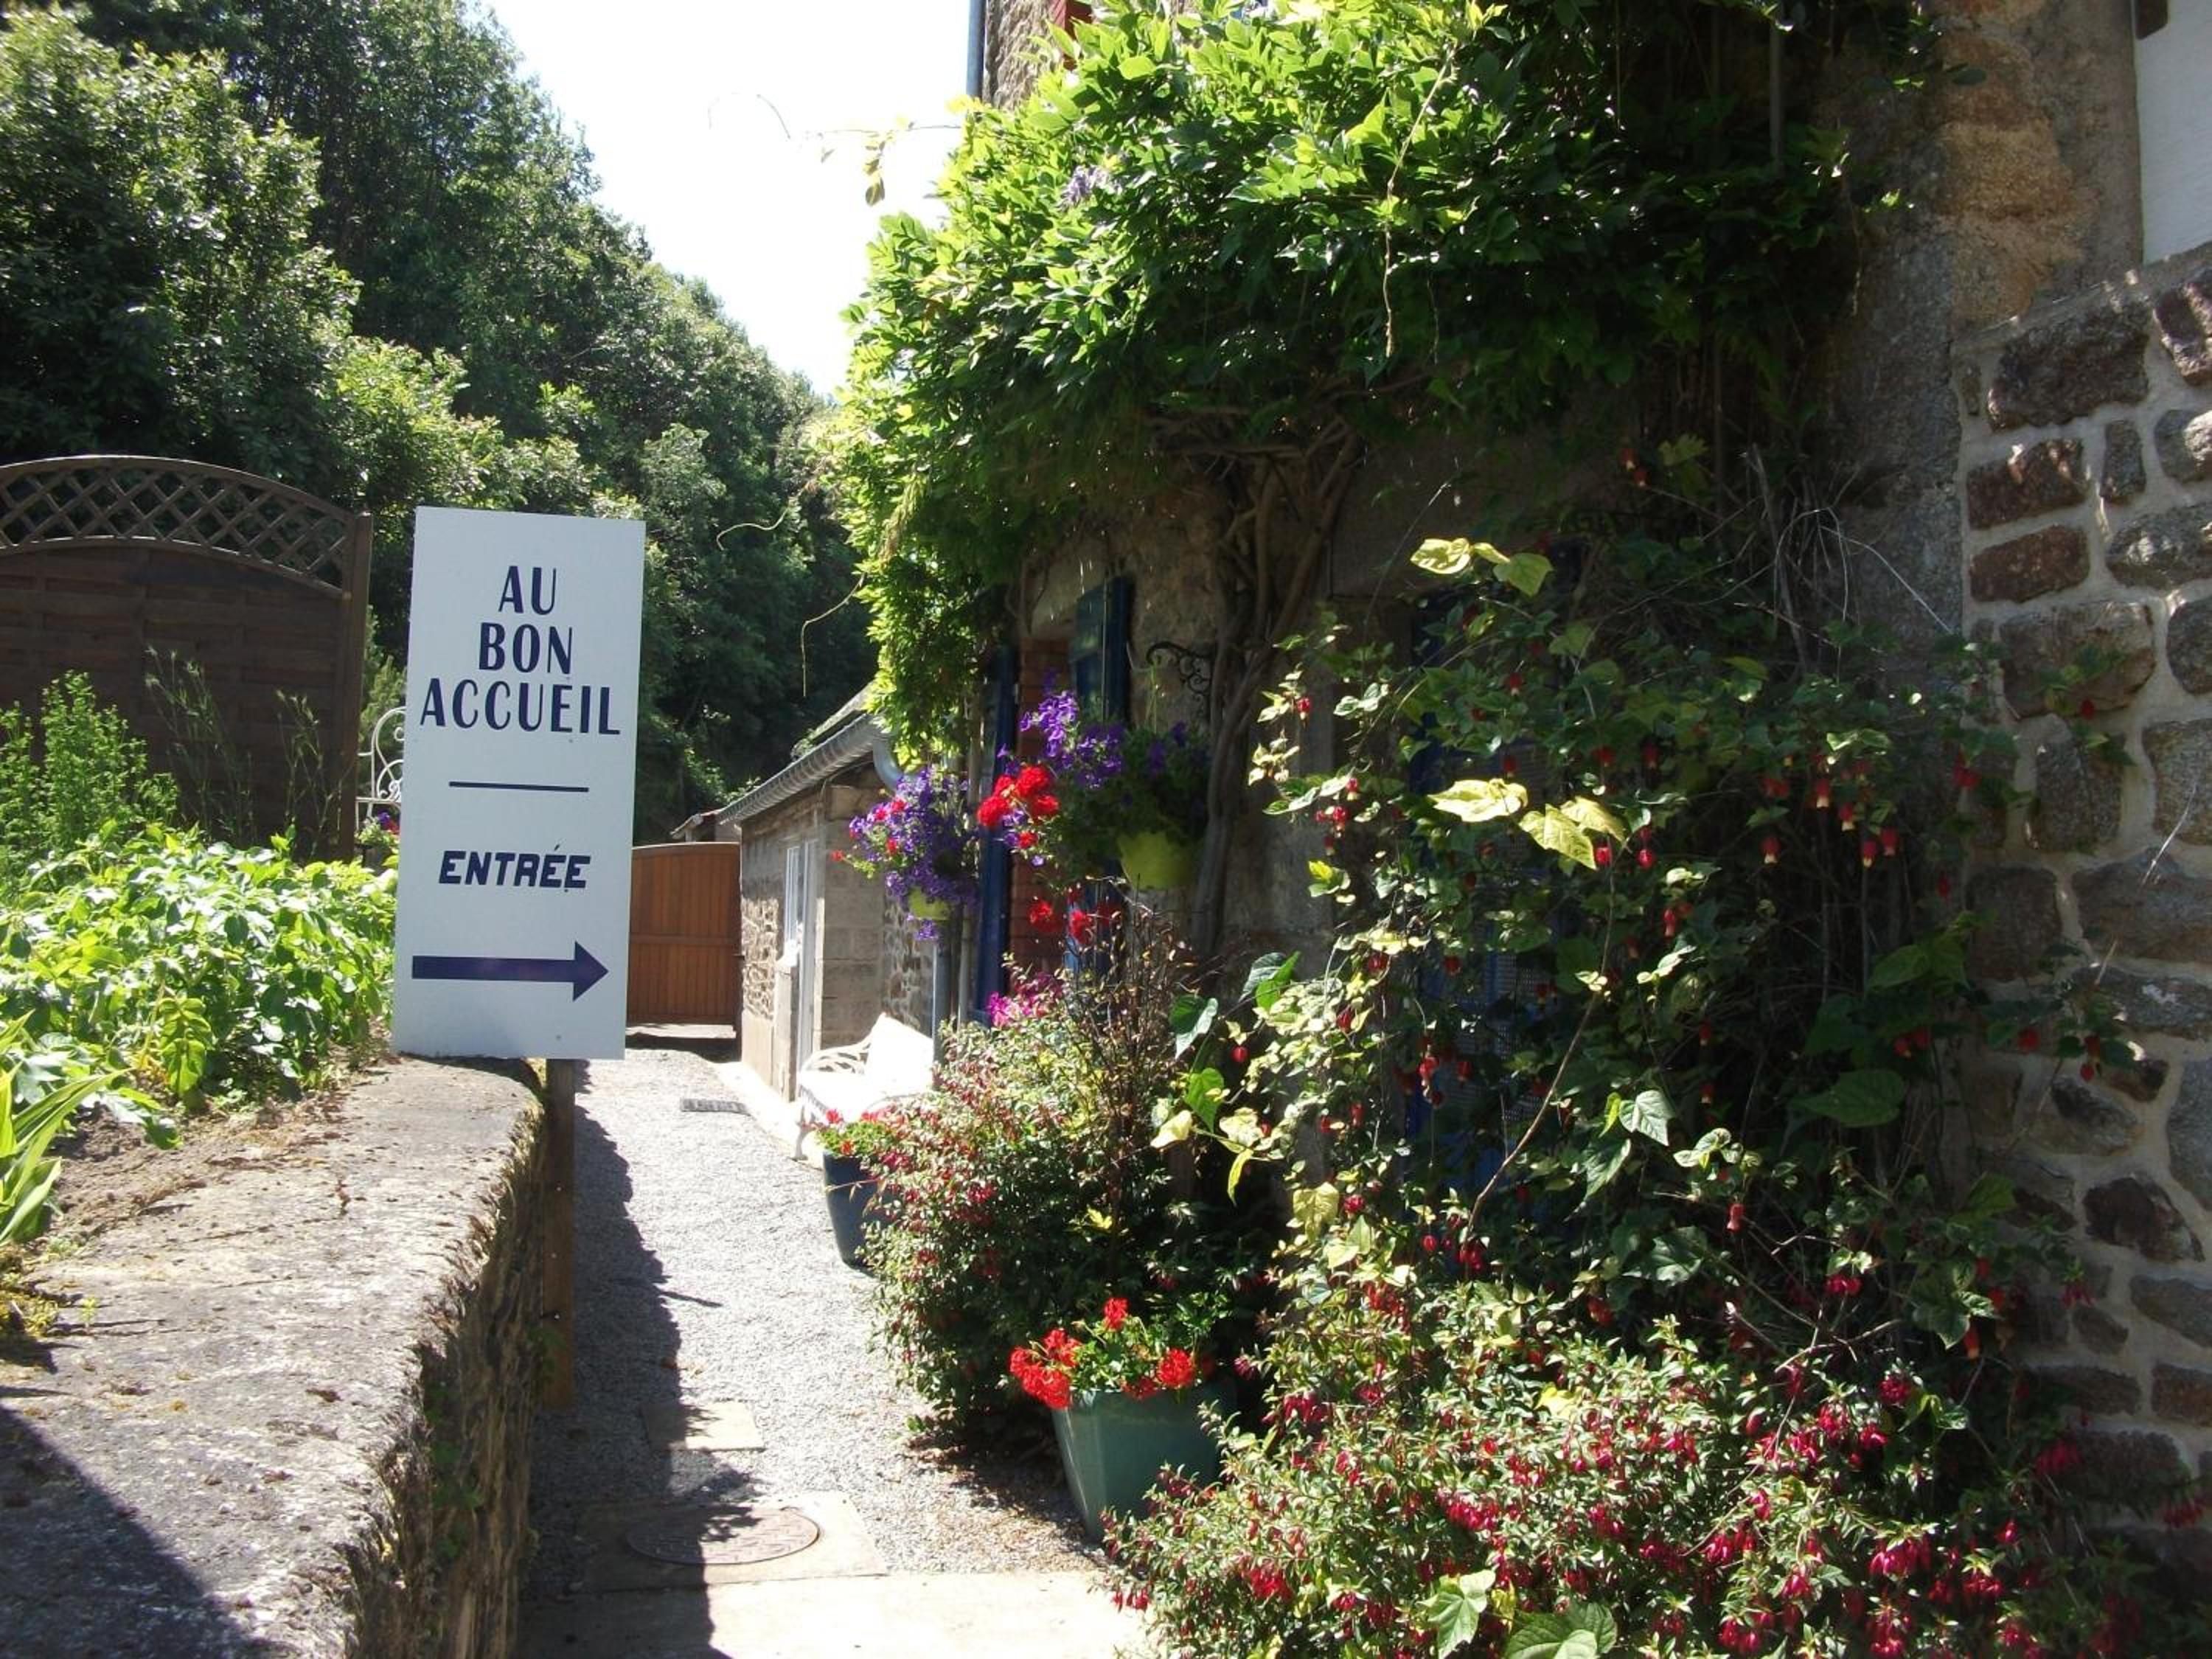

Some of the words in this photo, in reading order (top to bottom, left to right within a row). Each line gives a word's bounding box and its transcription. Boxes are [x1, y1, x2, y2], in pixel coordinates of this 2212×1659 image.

[498, 565, 558, 616] AU
[478, 622, 574, 675] BON
[420, 677, 621, 736] ACCUEIL
[438, 844, 592, 889] ENTRÉE
